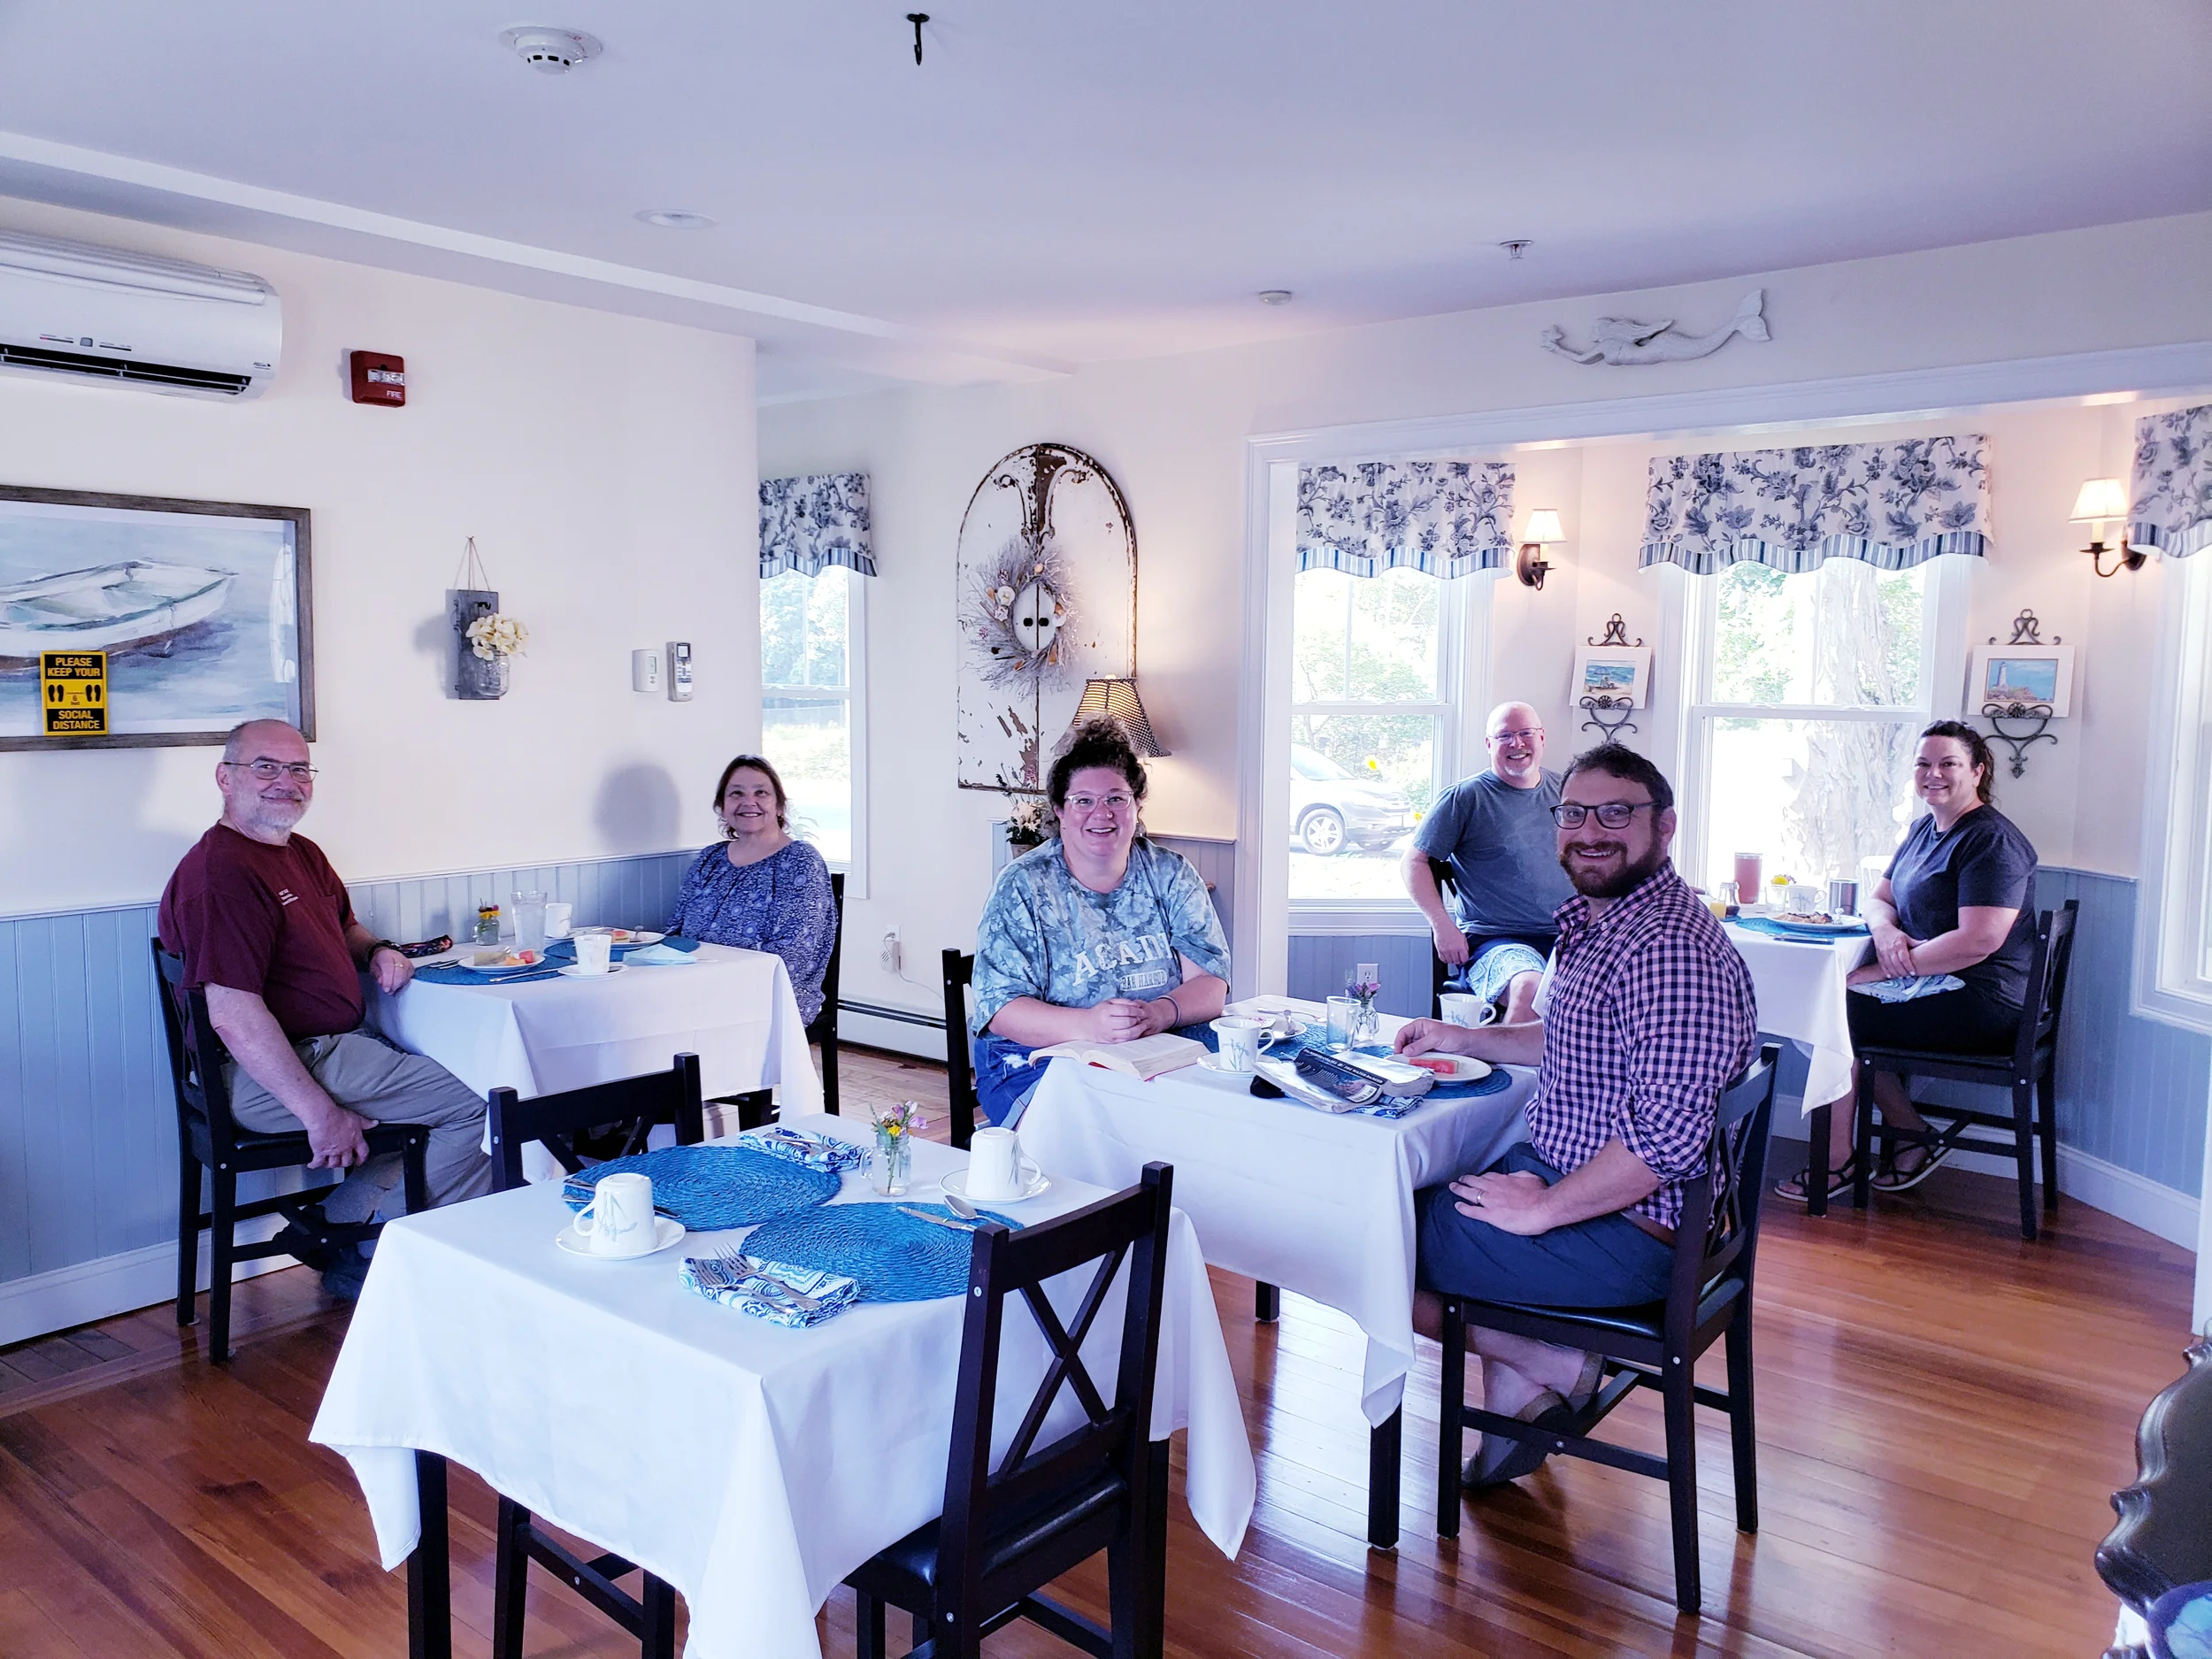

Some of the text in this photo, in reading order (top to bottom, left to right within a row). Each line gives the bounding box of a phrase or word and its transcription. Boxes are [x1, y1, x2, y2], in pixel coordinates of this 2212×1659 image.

[387, 390, 403, 400] FIRE
[55, 657, 92, 666] PLEASE
[47, 667, 100, 677] KEEP YOUR
[58, 710, 94, 719] SOCIAL
[53, 720, 100, 729] DISTANCE
[1122, 976, 1136, 989] BAR
